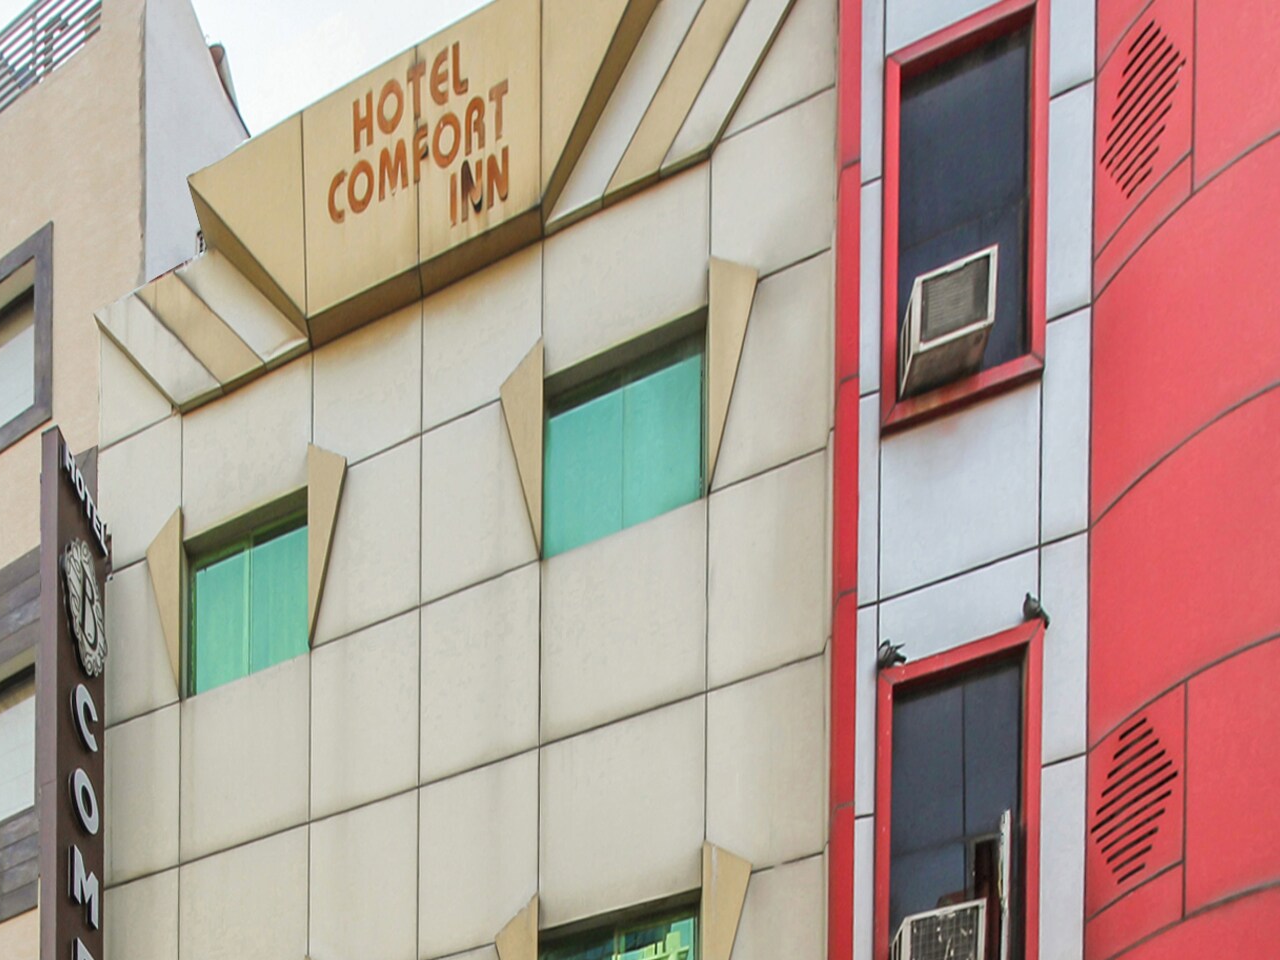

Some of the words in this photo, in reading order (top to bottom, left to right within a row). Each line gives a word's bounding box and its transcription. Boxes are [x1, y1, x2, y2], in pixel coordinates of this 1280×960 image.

[327, 79, 509, 224] COMFORT
[352, 41, 469, 154] HOTEL
[450, 146, 509, 228] INN
[62, 442, 108, 556] HOTEL
